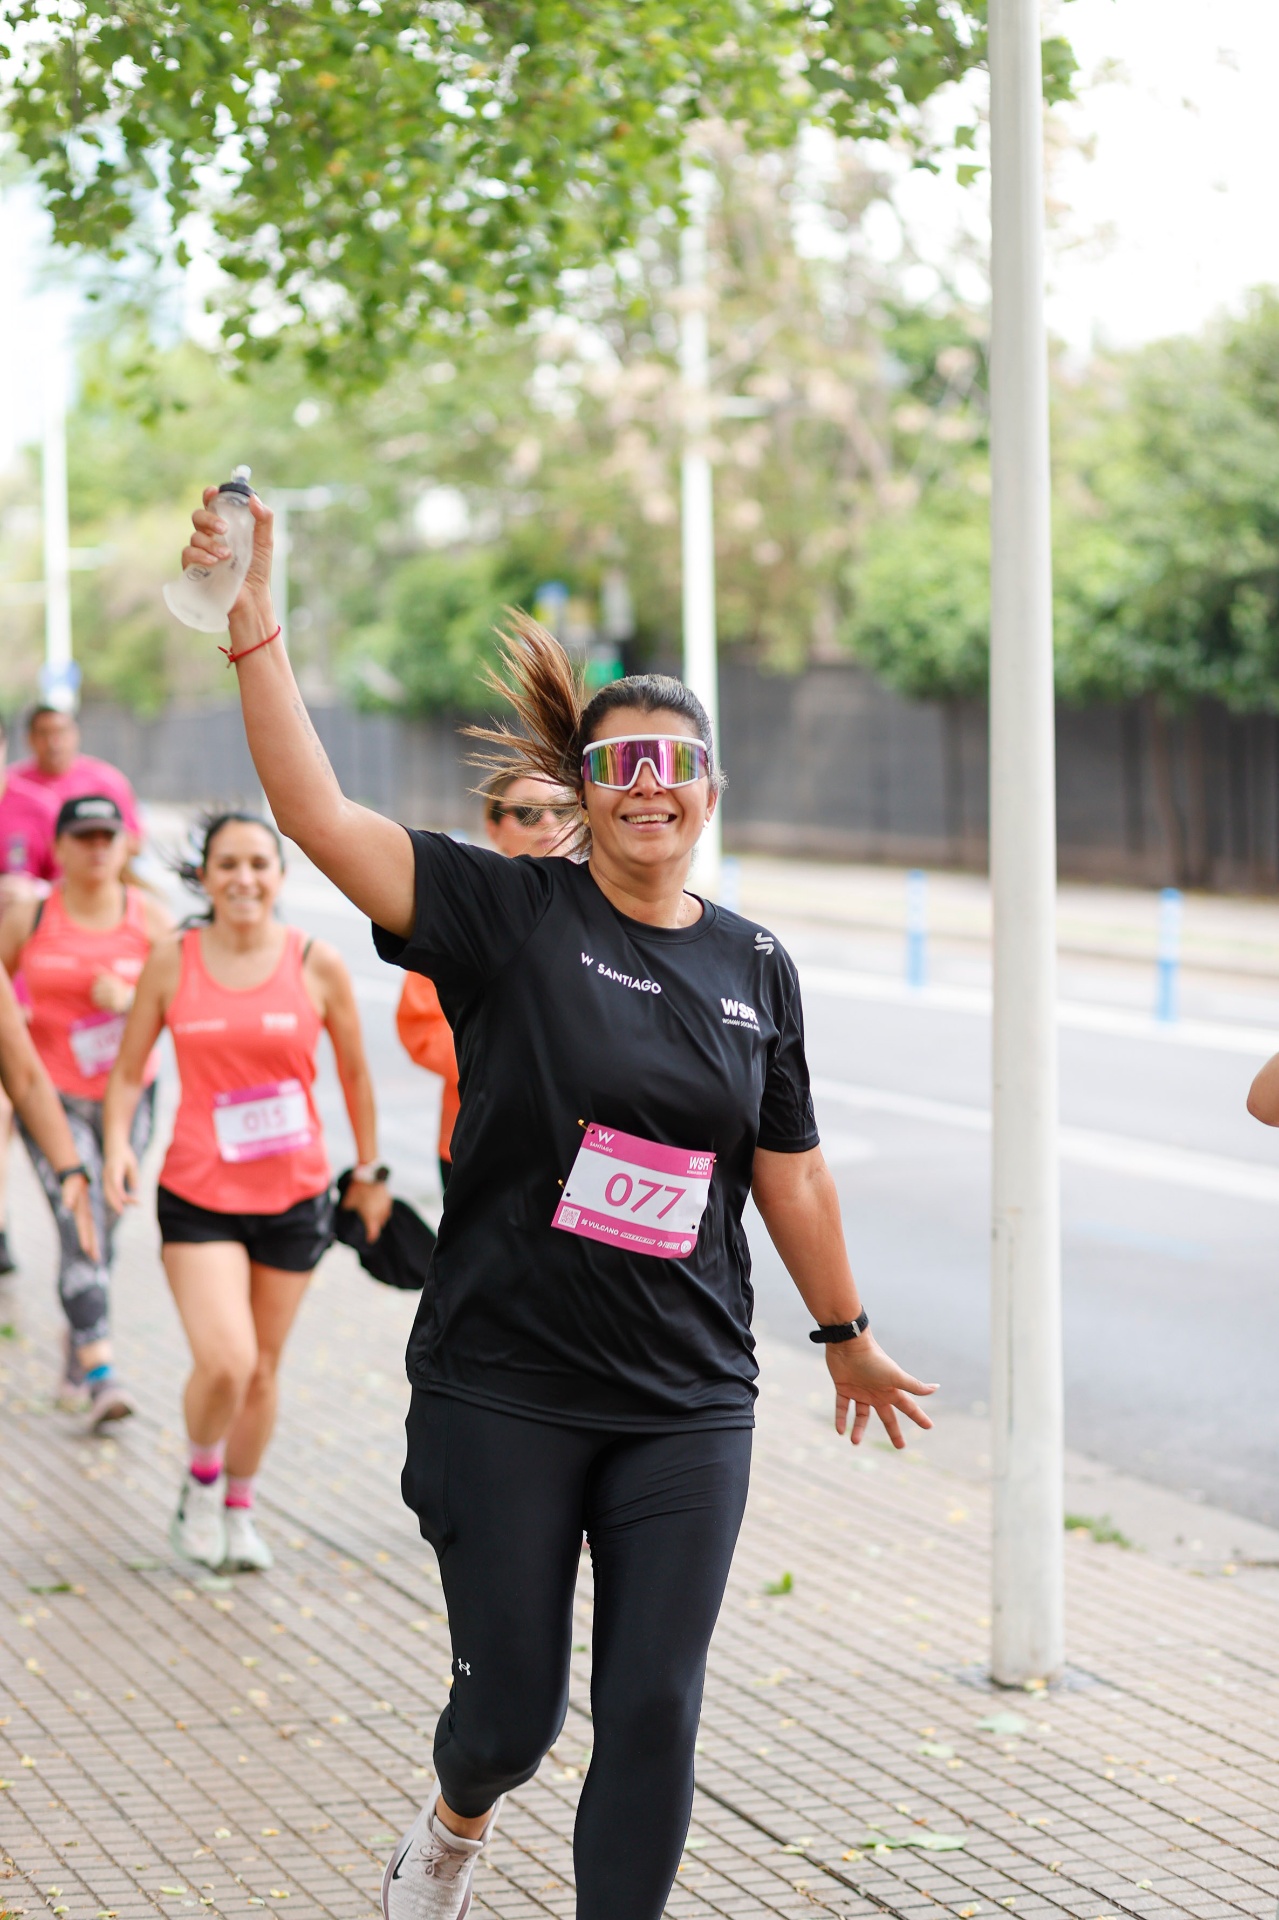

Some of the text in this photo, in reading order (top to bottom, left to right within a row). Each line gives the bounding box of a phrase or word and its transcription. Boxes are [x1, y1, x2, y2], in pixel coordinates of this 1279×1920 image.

[581, 952, 662, 995] W SANTIAGO
[721, 998, 759, 1025] WSR
[598, 1129, 615, 1145] W
[590, 1141, 614, 1153] SANTIAGO
[689, 1156, 710, 1171] WSR
[604, 1173, 687, 1220] 077
[588, 1221, 619, 1236] VULCANO
